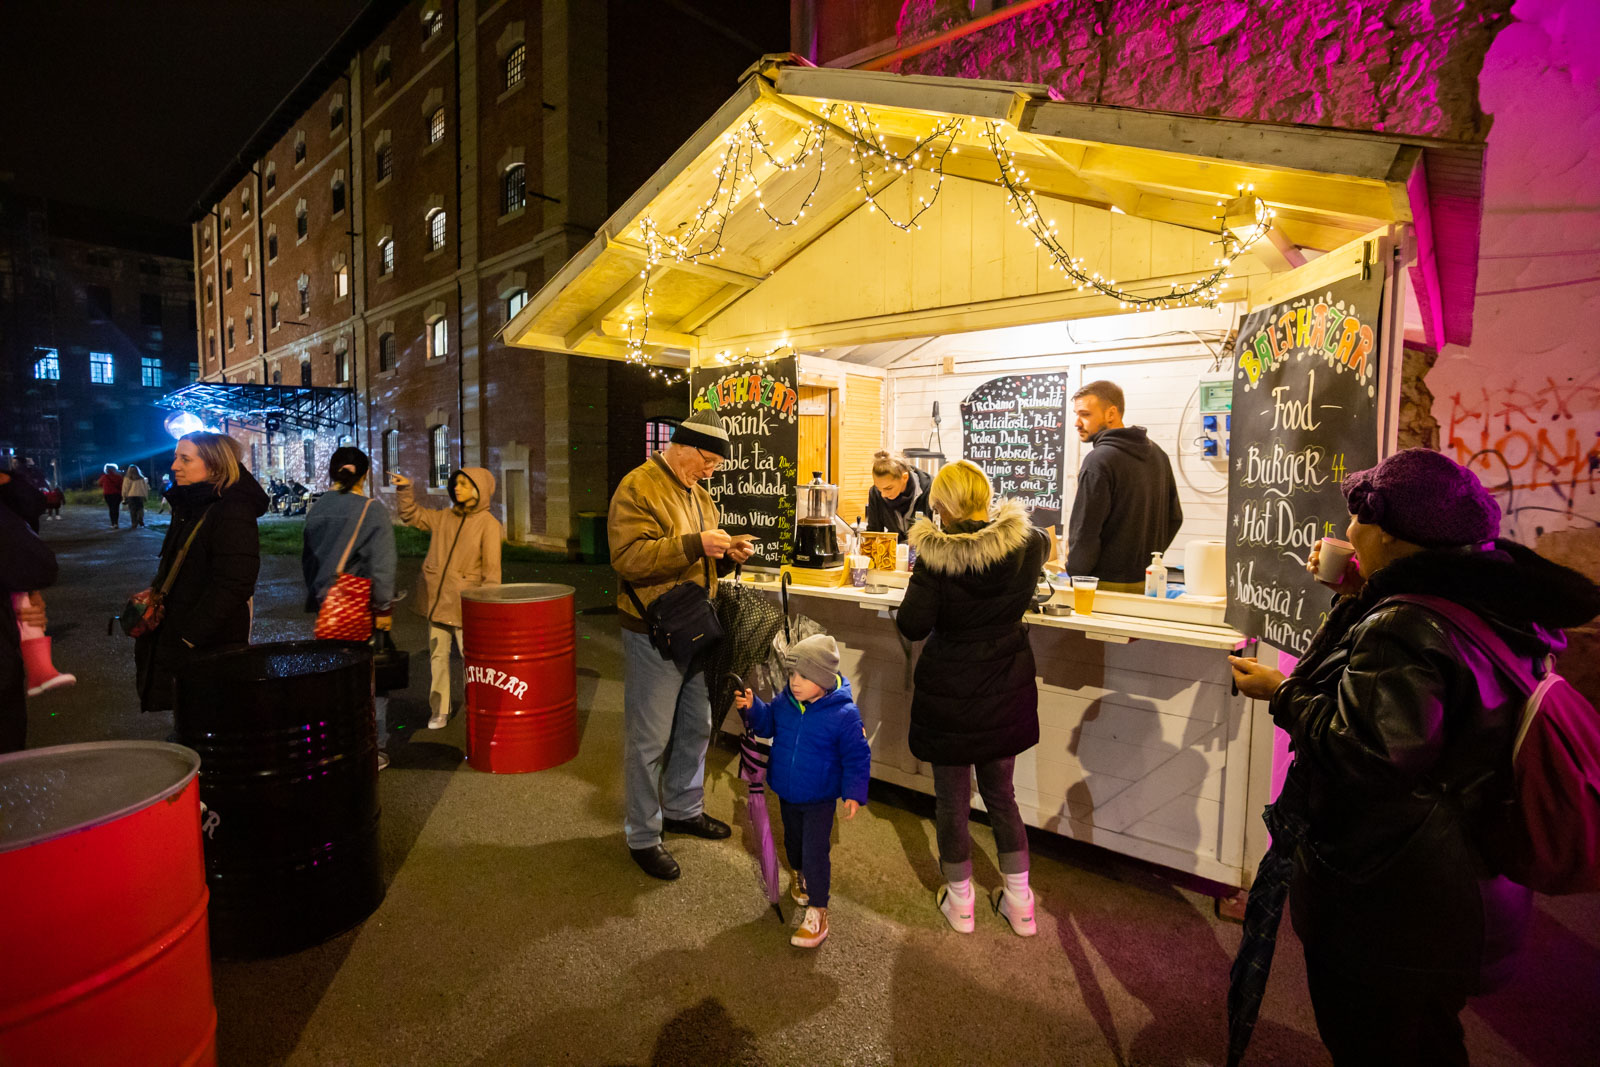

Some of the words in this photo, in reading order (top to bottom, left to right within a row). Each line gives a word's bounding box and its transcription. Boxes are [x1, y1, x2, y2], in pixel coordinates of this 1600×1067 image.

[1239, 303, 1373, 384] BALTHAZAR
[1270, 369, 1321, 431] Food
[723, 443, 750, 471] bble
[751, 442, 777, 471] tea
[1015, 465, 1026, 475] se
[702, 474, 735, 503] Topla
[1020, 480, 1044, 491] ona
[719, 504, 747, 526] hano
[749, 511, 778, 526] Vino
[1239, 501, 1272, 544] Hot
[1275, 500, 1316, 567] Dog
[1235, 560, 1290, 617] Kobasica
[1296, 589, 1306, 620] i
[464, 665, 528, 700] LTHAZAR
